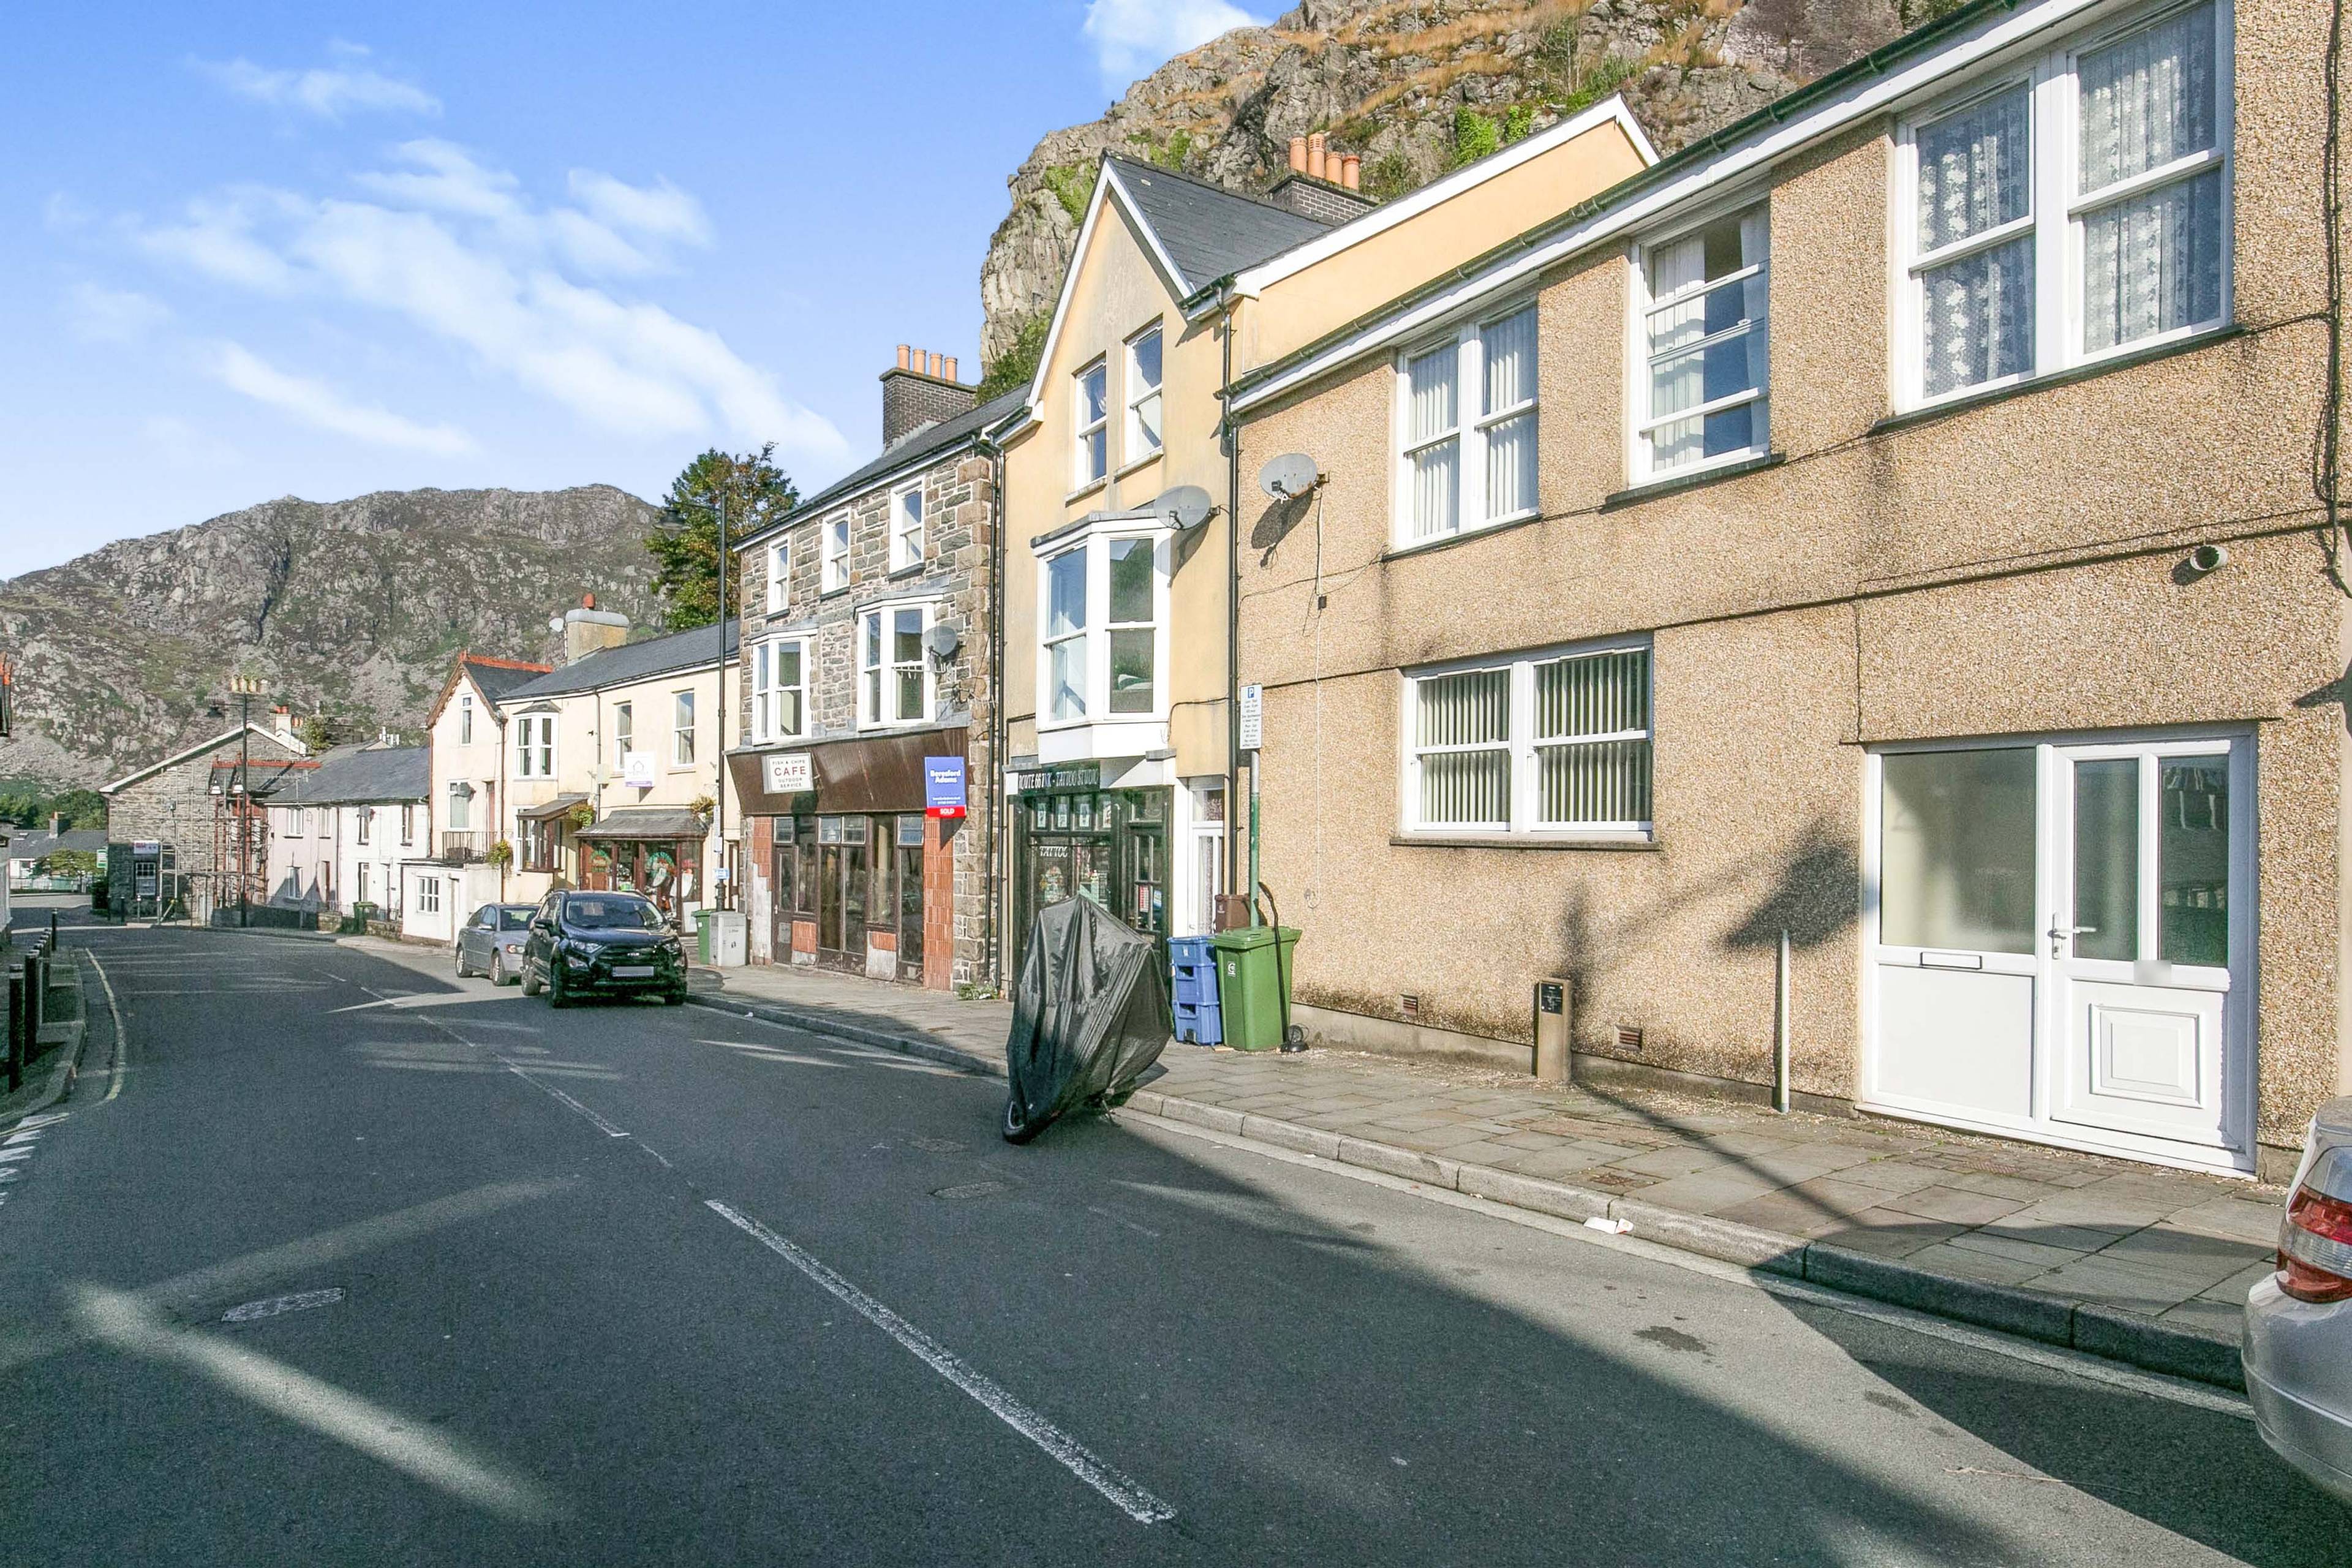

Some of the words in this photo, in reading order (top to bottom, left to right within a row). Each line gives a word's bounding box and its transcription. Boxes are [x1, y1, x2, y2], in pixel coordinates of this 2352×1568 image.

[774, 766, 806, 776] CAFE
[1019, 774, 1035, 790] ROUTE
[1035, 773, 1041, 788] 66
[1056, 771, 1077, 787] TATTOO
[1077, 769, 1098, 786] STUDIO
[1039, 846, 1068, 858] TATTOO
